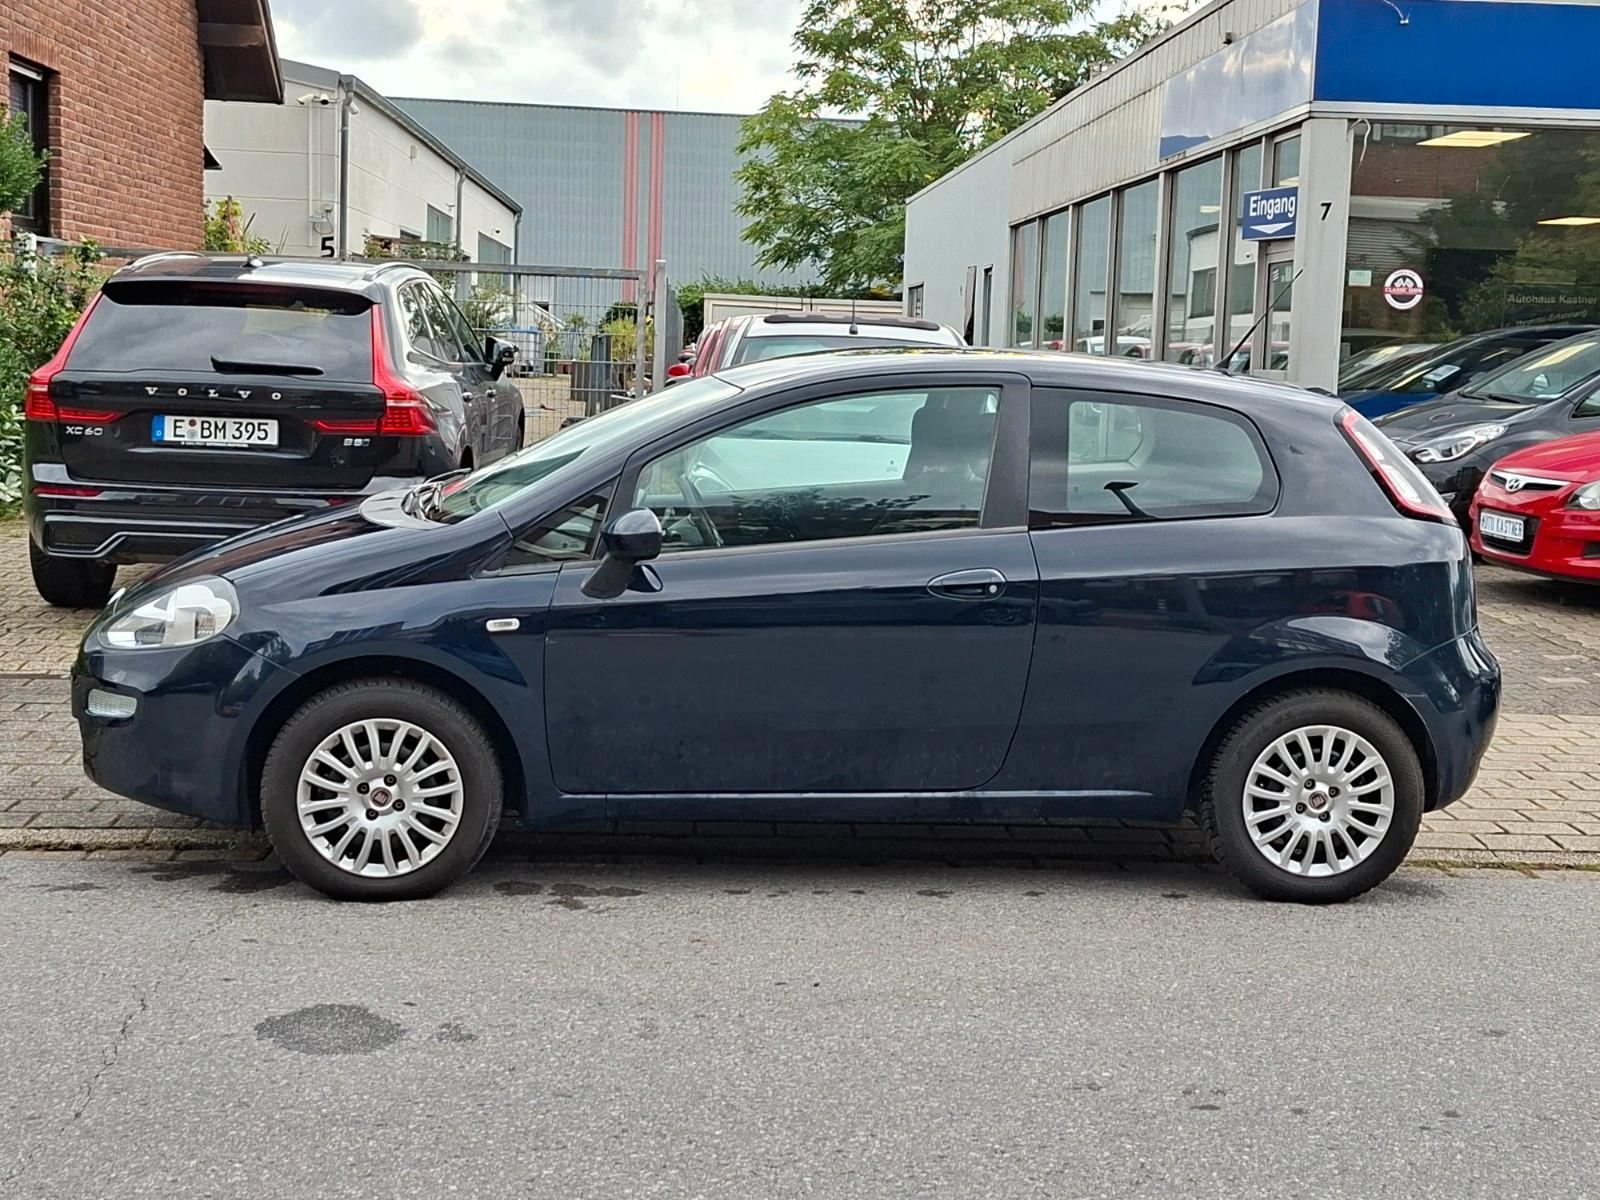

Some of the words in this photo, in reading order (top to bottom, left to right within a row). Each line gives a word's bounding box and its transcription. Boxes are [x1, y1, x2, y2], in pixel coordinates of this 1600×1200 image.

[1249, 195, 1296, 220] Eingang
[1320, 202, 1332, 221] 7
[321, 236, 335, 258] 5
[1507, 294, 1556, 304] Autohaus
[1559, 295, 1597, 305] Kastner
[145, 386, 282, 400] VOLVO
[173, 419, 185, 438] E
[200, 420, 226, 439] BM
[232, 421, 269, 441] 395
[1497, 517, 1523, 537] KASTNER
